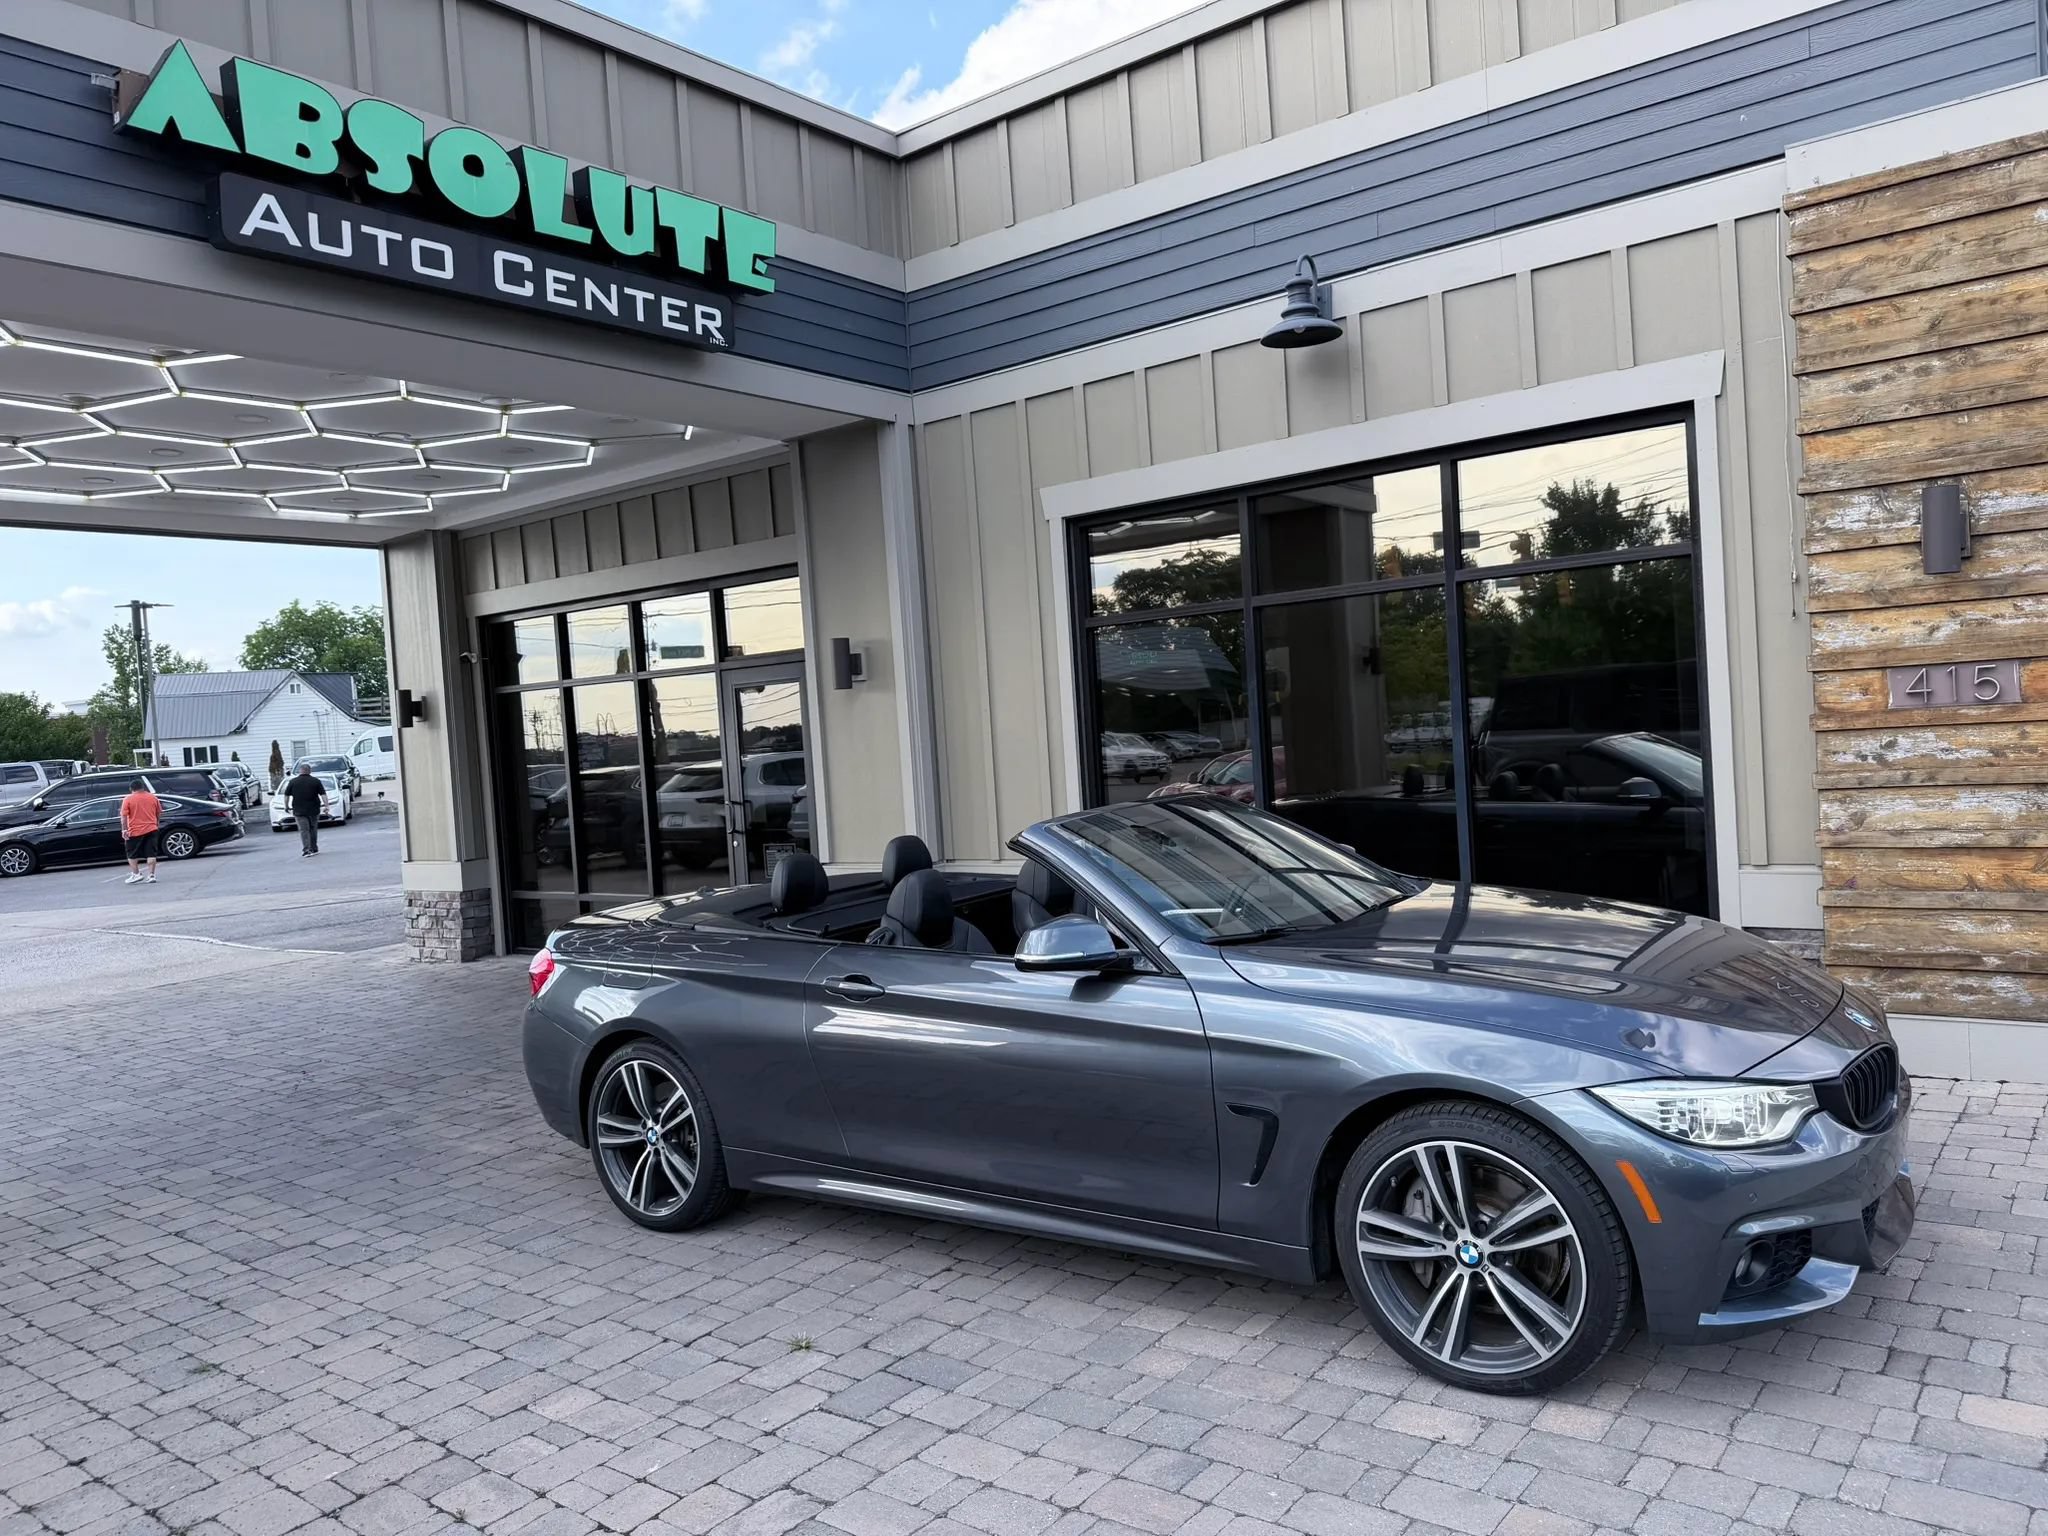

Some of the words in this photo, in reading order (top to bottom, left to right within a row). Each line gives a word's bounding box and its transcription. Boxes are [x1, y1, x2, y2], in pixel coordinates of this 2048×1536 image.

[125, 38, 776, 294] ABSOLUTE
[238, 193, 455, 280] AUTO
[493, 250, 725, 340] CENTER
[1905, 664, 2001, 703] 415
